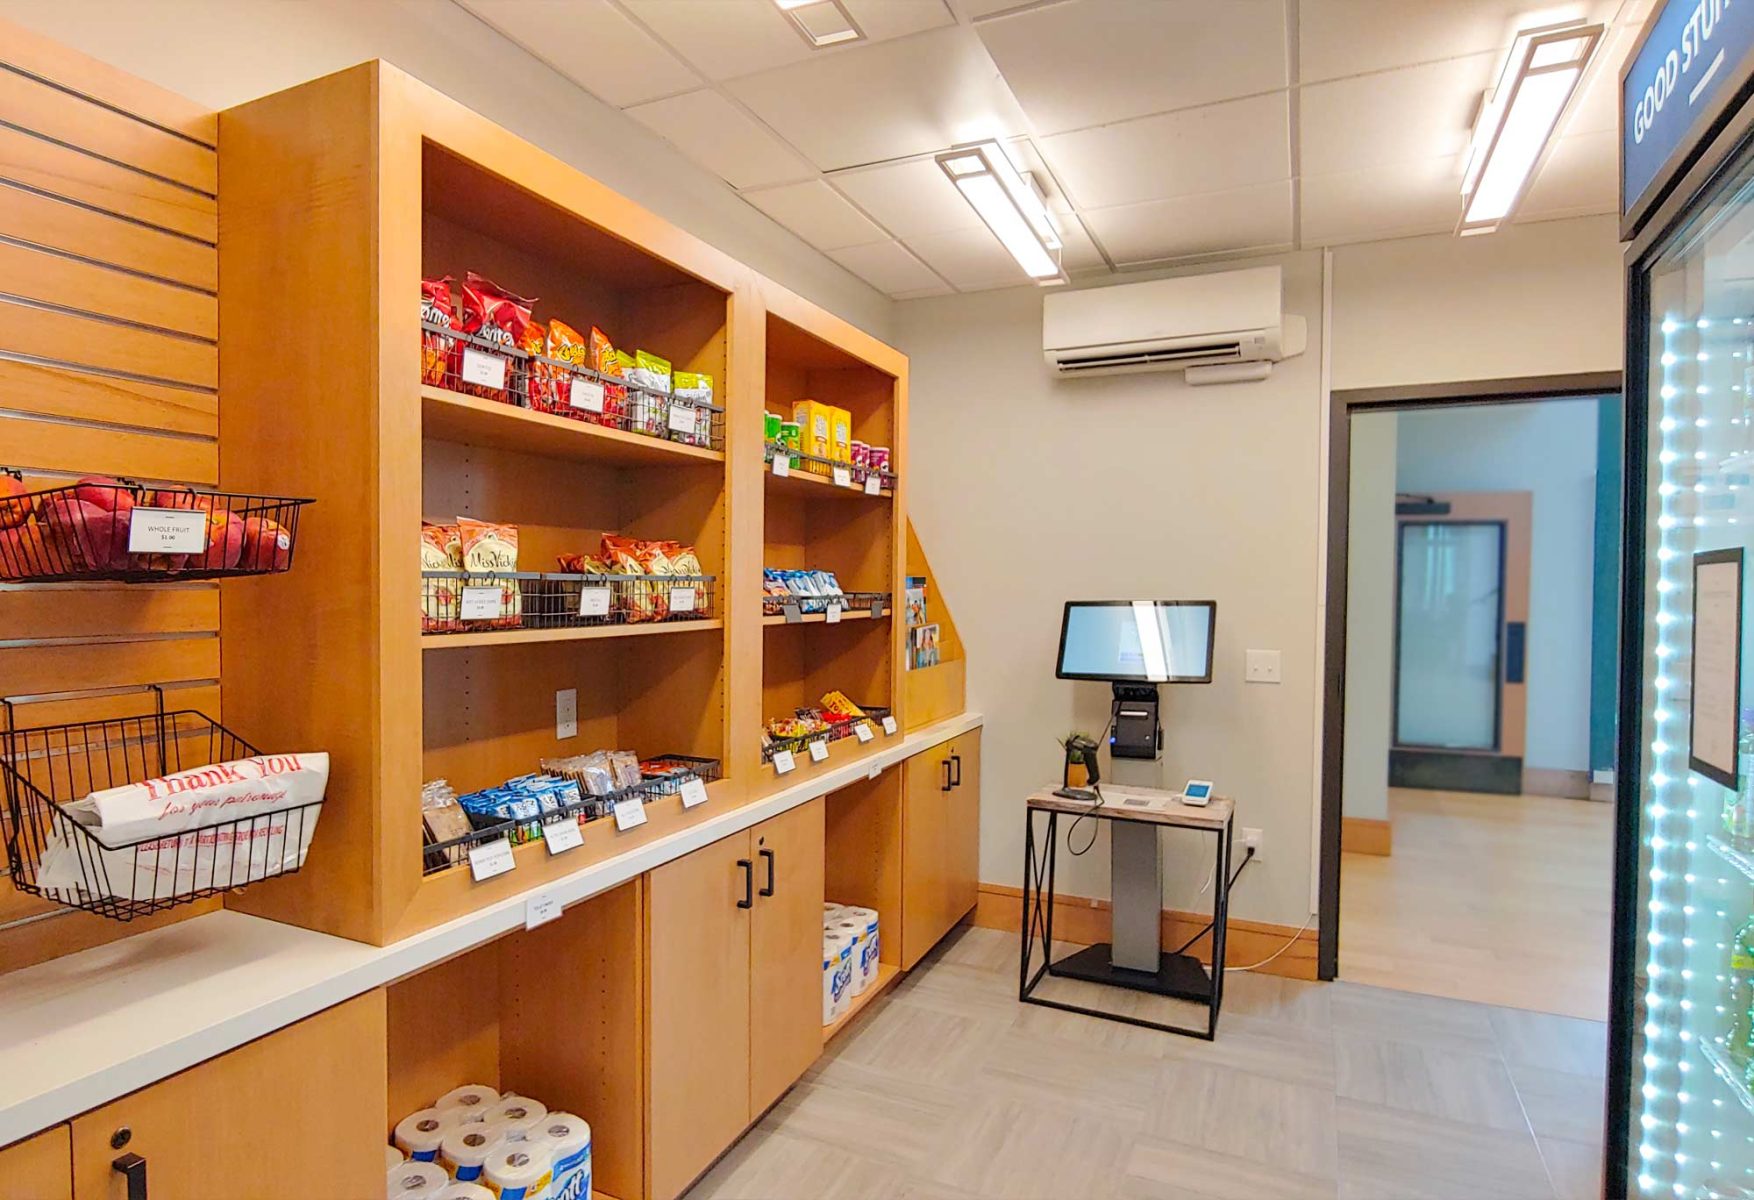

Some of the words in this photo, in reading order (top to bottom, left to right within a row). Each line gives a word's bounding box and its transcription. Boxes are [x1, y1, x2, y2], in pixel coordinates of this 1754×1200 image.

[1634, 49, 1678, 144] GOOD
[1682, 0, 1730, 74] STU
[470, 552, 494, 568] Miss
[135, 763, 247, 802] Thank
[248, 753, 304, 779] You
[158, 801, 185, 821] for
[189, 798, 220, 815] your
